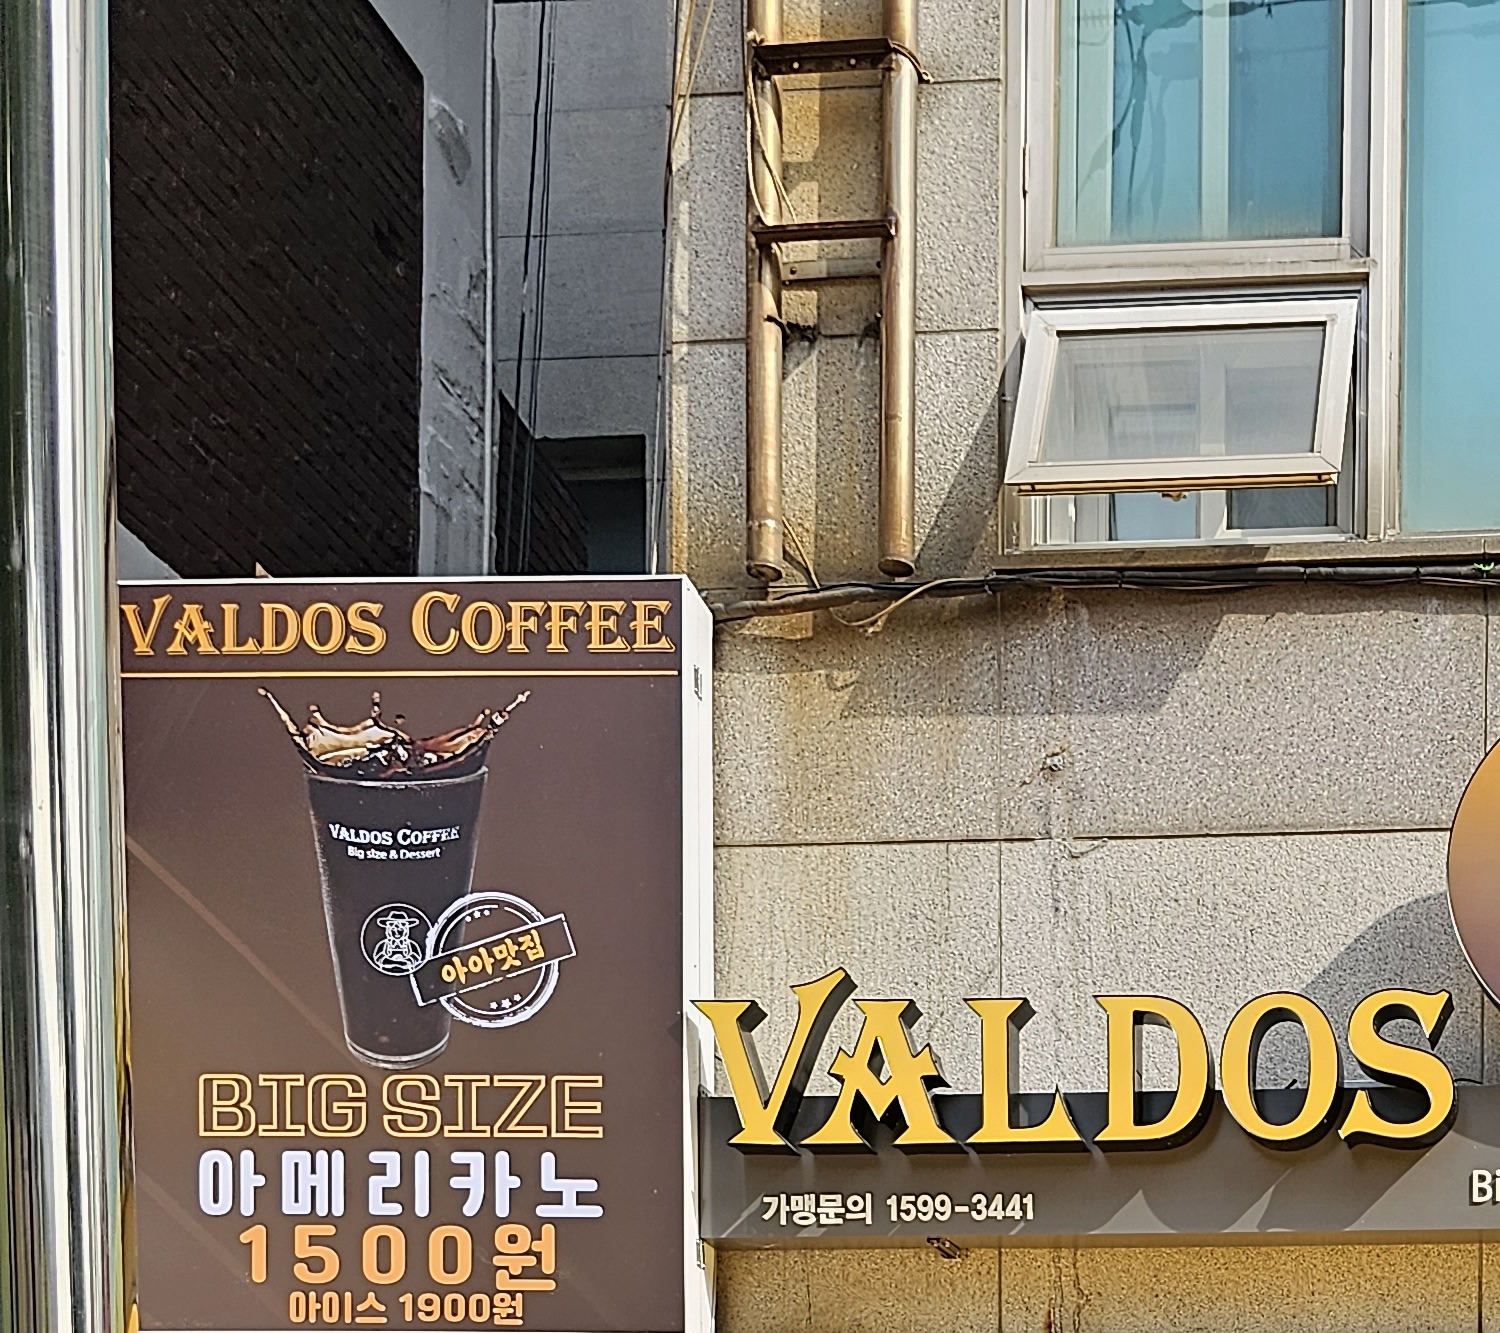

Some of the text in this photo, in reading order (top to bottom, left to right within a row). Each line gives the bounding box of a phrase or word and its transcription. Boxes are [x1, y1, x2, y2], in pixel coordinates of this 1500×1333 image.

[119, 591, 675, 656] VALDOS COFFEE
[329, 823, 461, 845] VALDOS COFFEE
[347, 846, 441, 860] Big size & Dessert
[441, 928, 546, 985] 아아맛집
[700, 967, 1456, 1151] VALDOS
[198, 1074, 604, 1139] BIG SIZE
[200, 1149, 605, 1219] 아메리카노
[762, 1193, 1035, 1226] 가맹문의 1599-3441
[239, 1223, 556, 1292] 1500원
[289, 1291, 524, 1326] 아이스 1900원
